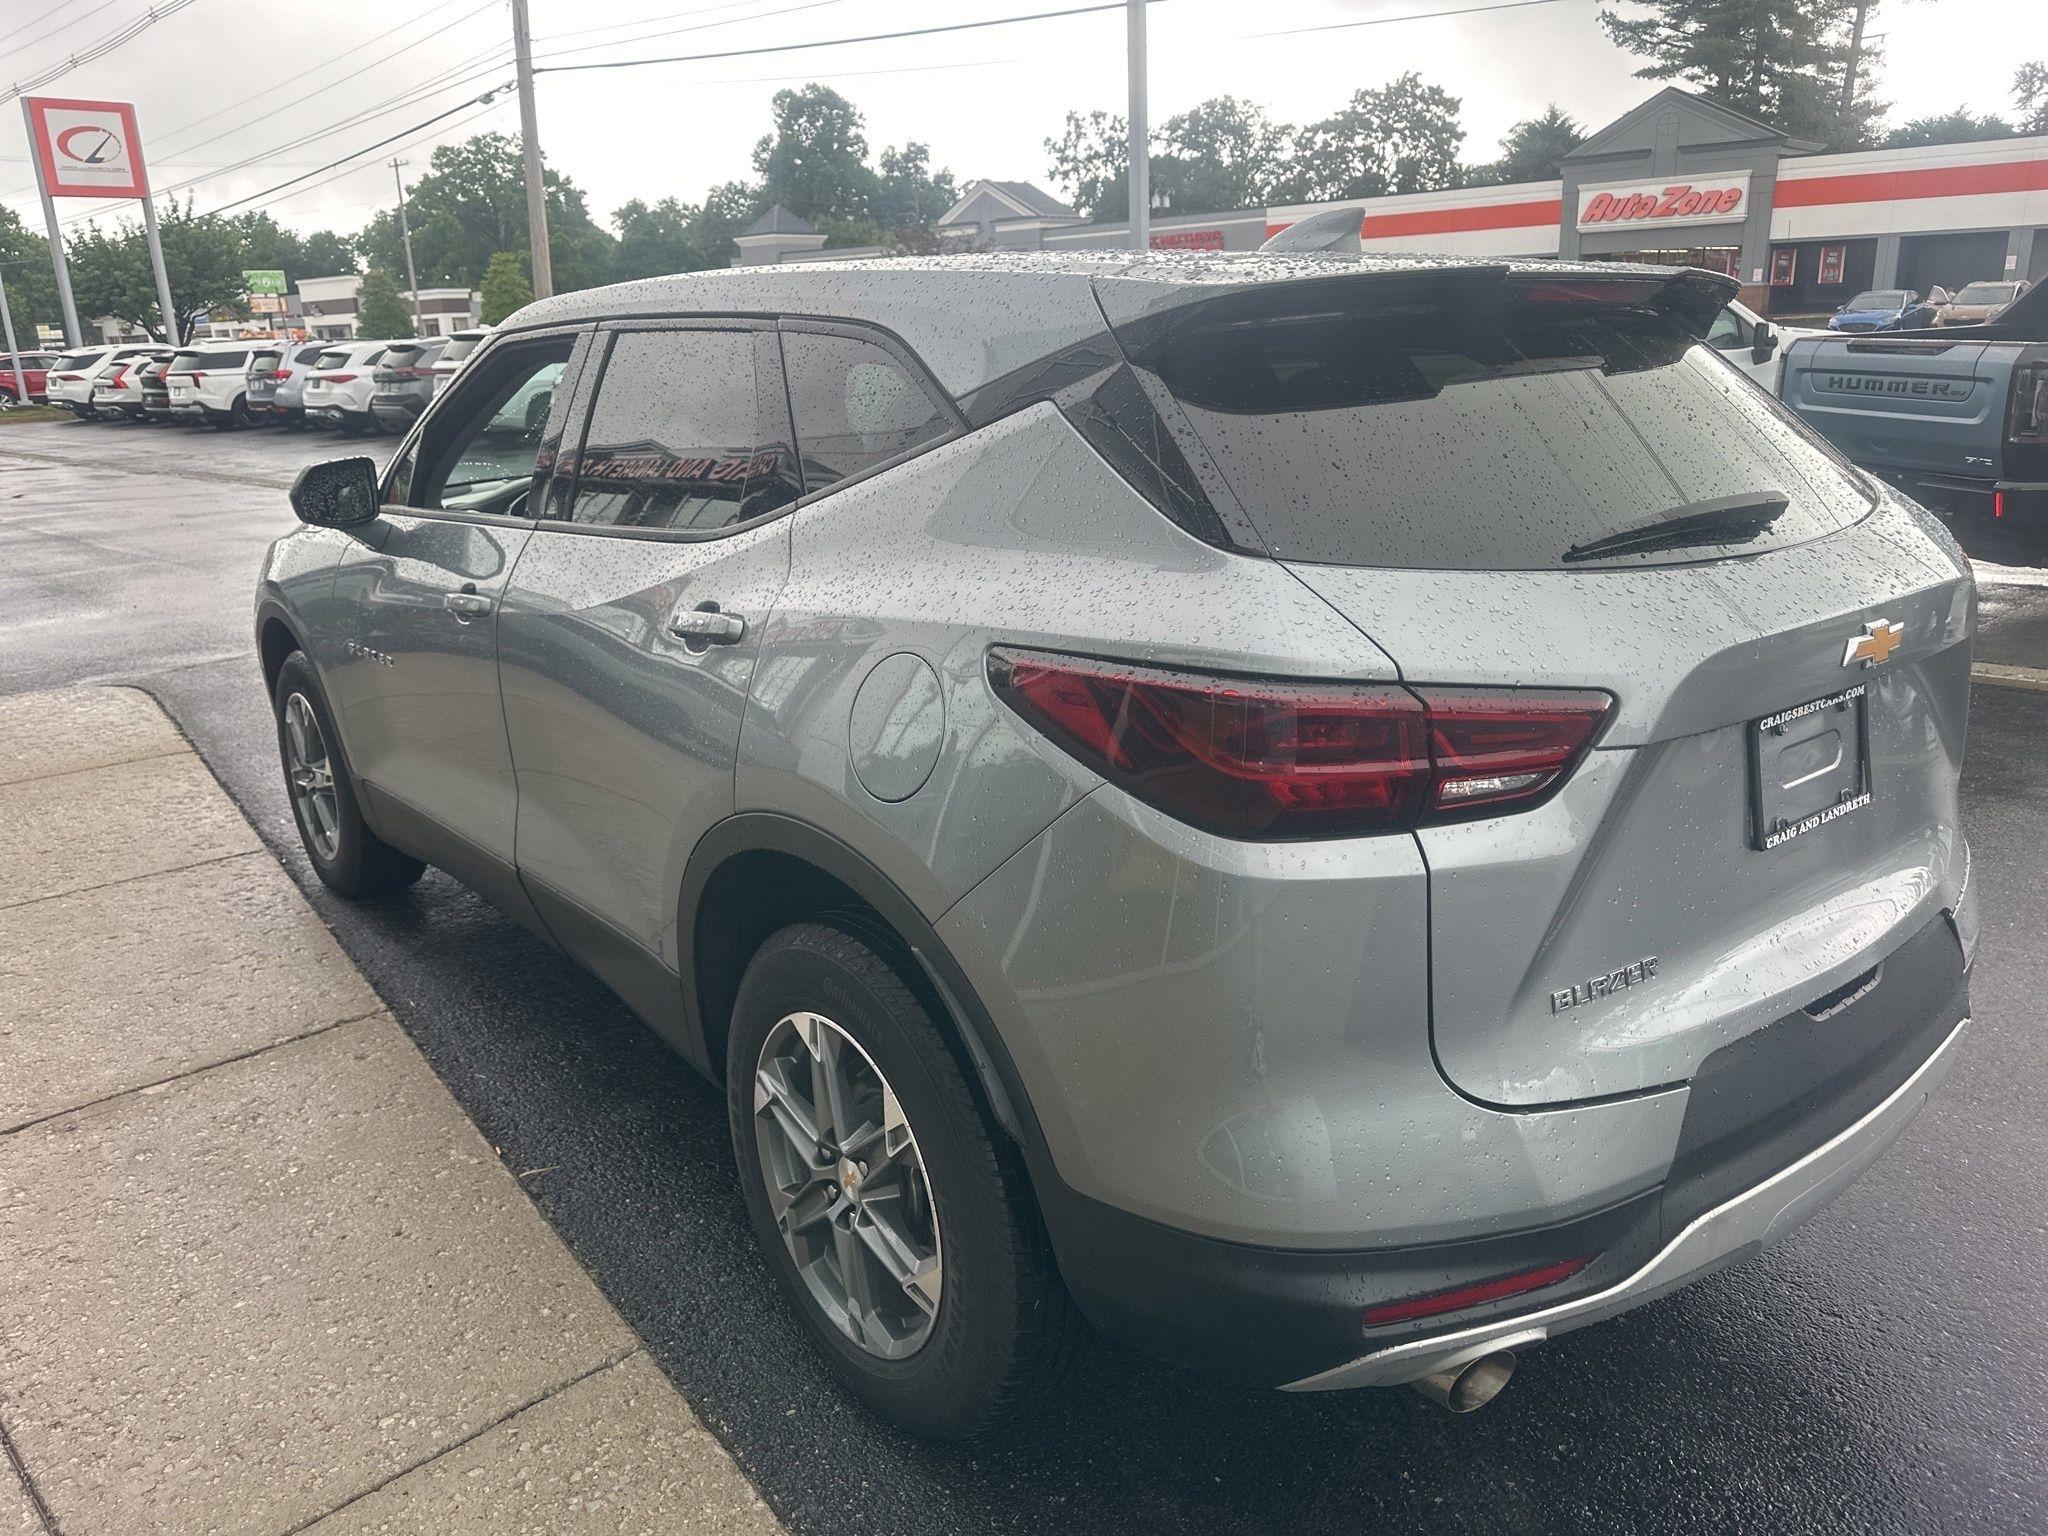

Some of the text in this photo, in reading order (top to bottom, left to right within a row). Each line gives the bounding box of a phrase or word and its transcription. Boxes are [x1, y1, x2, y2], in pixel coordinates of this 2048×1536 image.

[1580, 185, 1742, 223] AutoZone
[1828, 376, 1949, 395] HUMMER
[1766, 792, 1871, 849] CRAIG AND LANDRETH
[1551, 955, 1658, 1016] BLAZER
